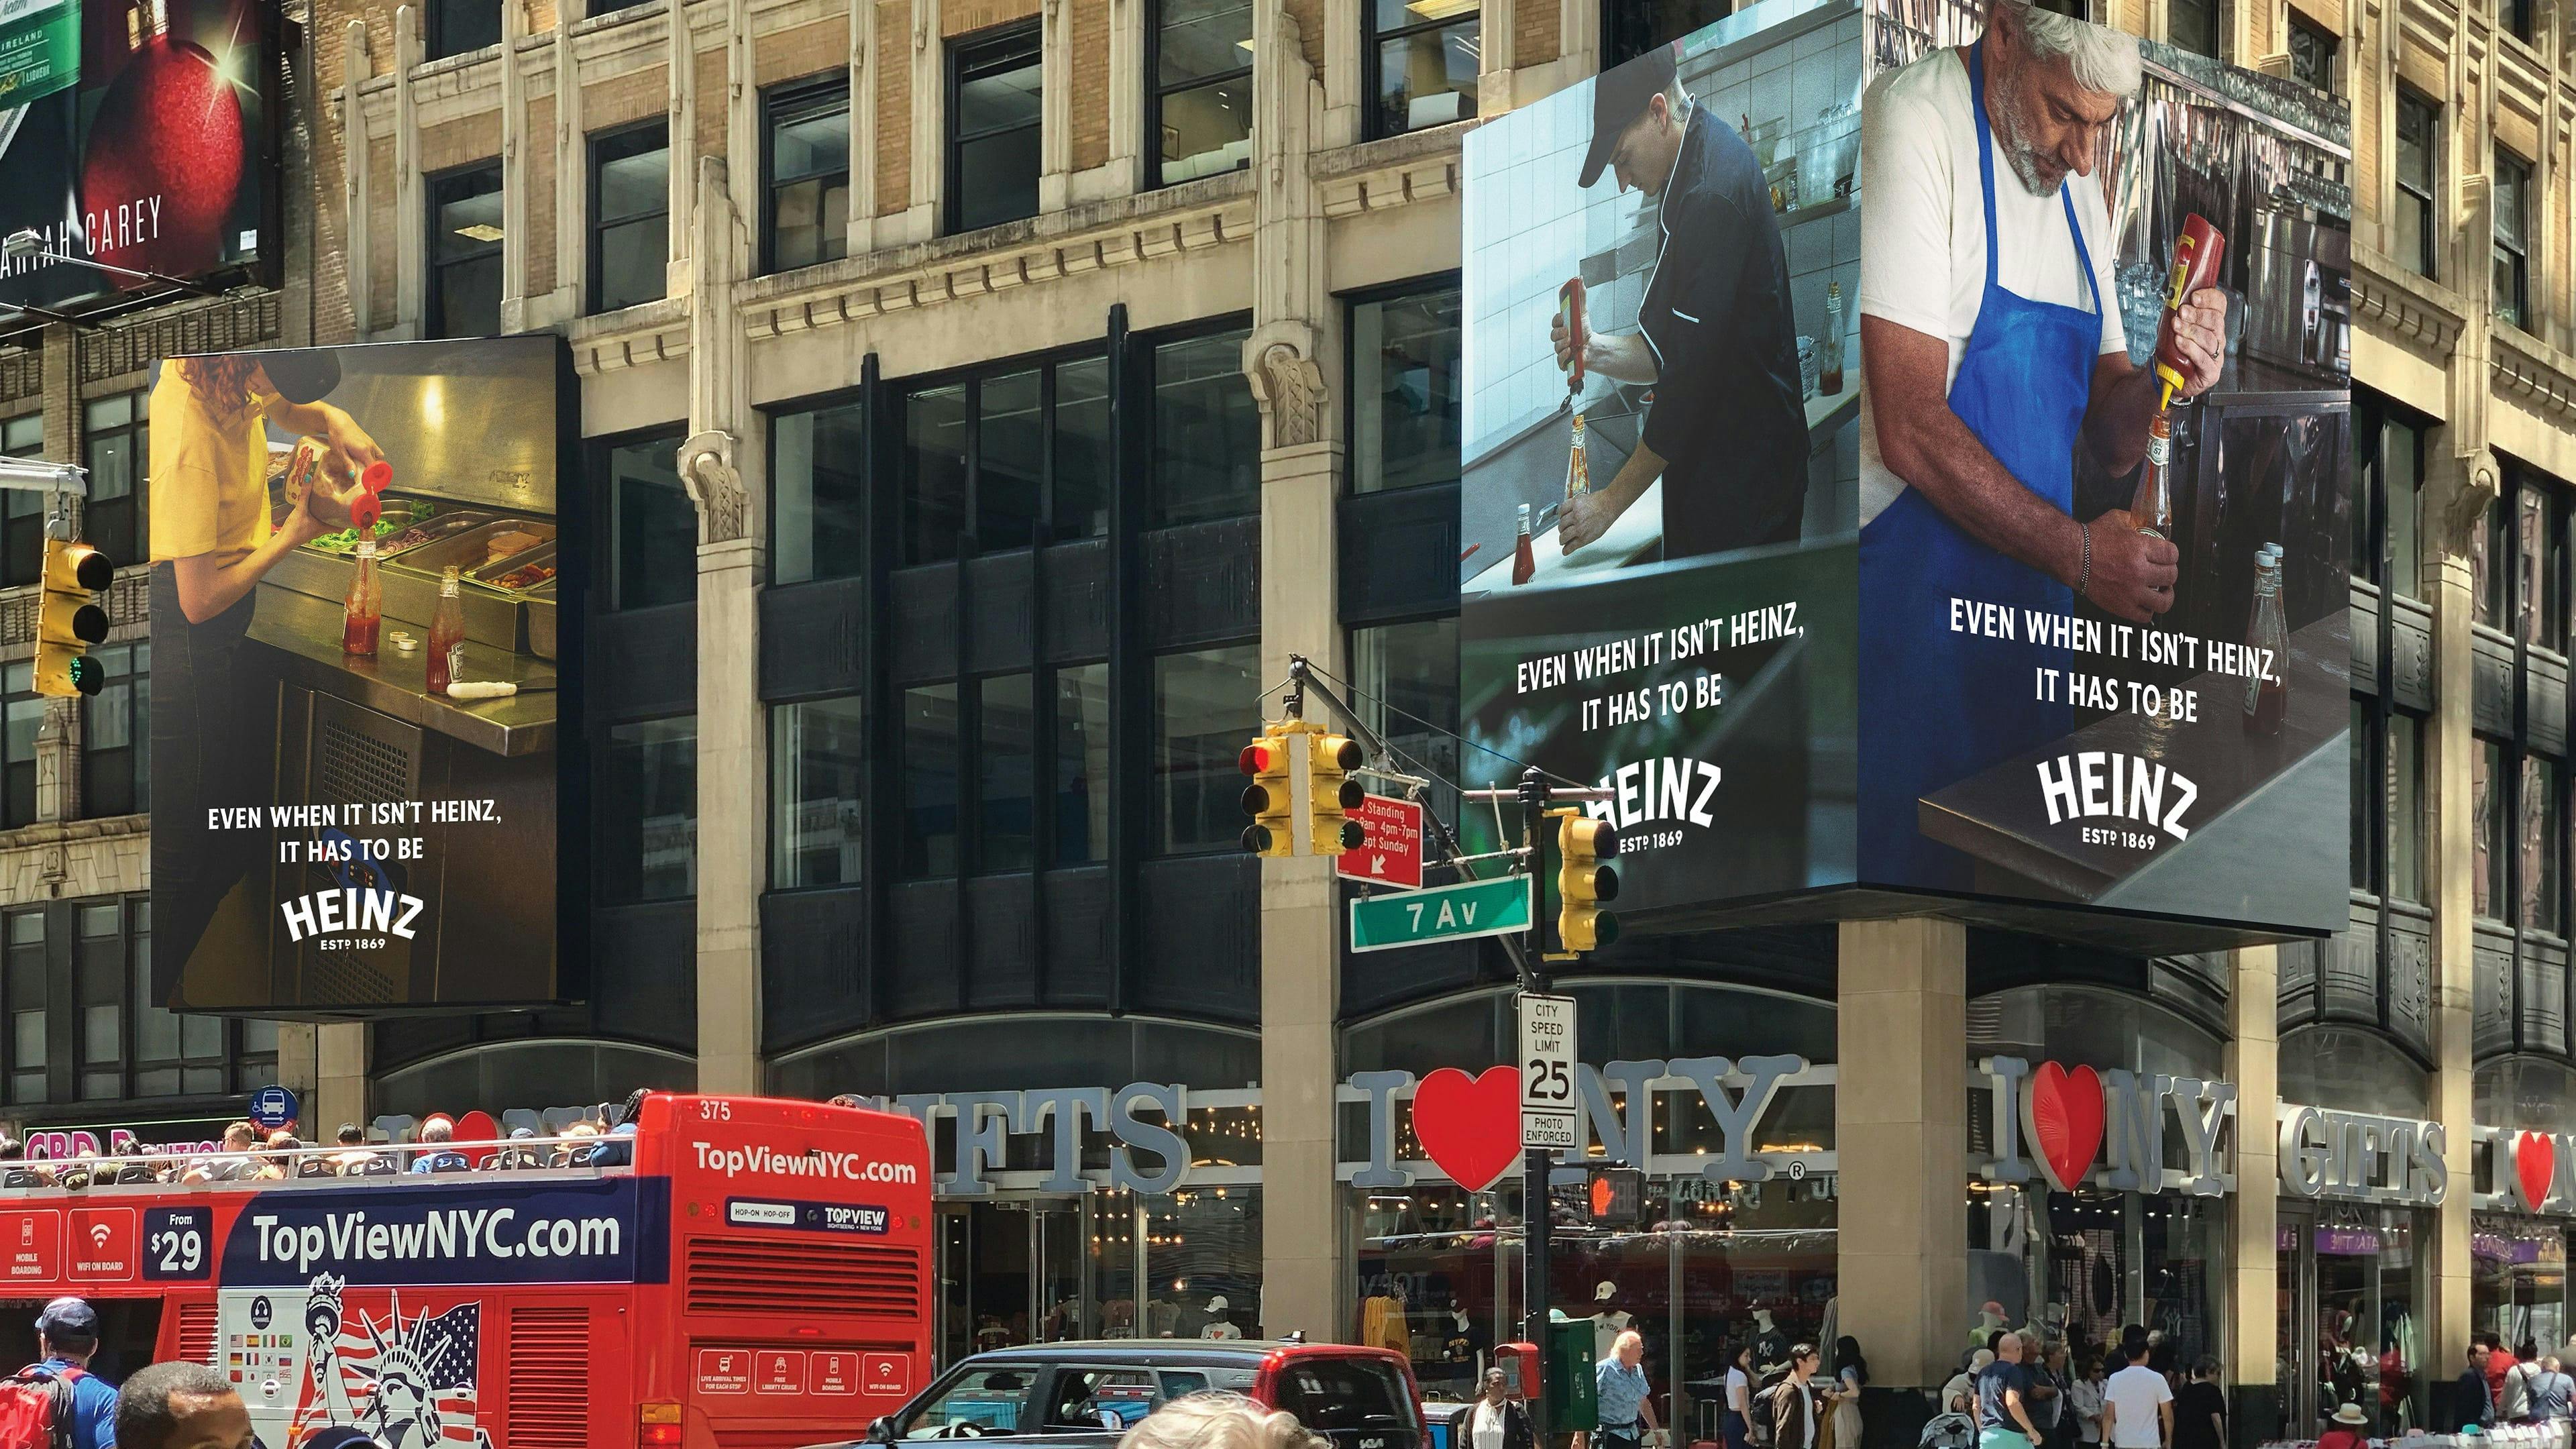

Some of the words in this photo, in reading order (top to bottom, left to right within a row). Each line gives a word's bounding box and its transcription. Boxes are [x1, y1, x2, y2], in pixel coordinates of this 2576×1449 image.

[1, 30, 42, 51] IRELAND
[86, 195, 161, 256] CAREY
[1517, 653, 1566, 694] EVEN
[1573, 638, 1635, 681] WHEN
[1644, 631, 1663, 666] IT
[1670, 618, 1723, 661] ISN'T
[1731, 601, 1803, 647] HEINZ,
[1950, 597, 2015, 639] EVEN
[2025, 609, 2101, 653] WHEN
[2110, 624, 2133, 658] IT
[2141, 629, 2199, 668] ISN'T
[2208, 641, 2281, 686] HEINZ,
[1582, 698, 1601, 732] IT
[1609, 688, 1650, 726] HAS
[1658, 681, 1688, 716] TO
[1696, 673, 1721, 709] BE
[2037, 667, 2059, 702] IT
[2069, 672, 2118, 711] HAS
[2127, 682, 2161, 716] TO
[2170, 688, 2197, 722] BE
[2036, 751, 2197, 841] HEINZ
[209, 807, 261, 829] EVEN
[270, 805, 335, 827] WHEN
[343, 804, 363, 825] IT
[372, 802, 423, 824] ISN'T
[431, 800, 501, 824] HEINZ,
[1367, 801, 1405, 823] Standing
[1381, 821, 1417, 839] 4pm-7pm
[1652, 830, 1682, 849] 1869
[2121, 832, 2155, 850] 1869
[280, 841, 300, 863] IT
[308, 839, 352, 862] HAS
[360, 839, 389, 861] TO
[398, 838, 423, 859] BE
[1379, 837, 1409, 857] Sunday
[280, 888, 423, 942] HEINZ
[1406, 903, 1424, 932] 7
[1436, 899, 1477, 929] Av
[355, 938, 385, 949] 1869
[1536, 1004, 1558, 1017] CITY
[1531, 1022, 1563, 1035] SPEED
[1536, 1040, 1560, 1052] LIMIT
[1529, 1059, 1569, 1100] 25
[700, 1099, 731, 1121] 375
[1351, 1071, 1414, 1188] I
[1551, 1054, 1809, 1186] NY
[253, 1120, 262, 1130] NO
[1535, 1118, 1563, 1129] PHOTO
[1980, 1055, 2029, 1182] I
[2095, 1068, 2238, 1198] NY
[1526, 1130, 1571, 1142] ENFORCED
[25, 1130, 97, 1173] CBD
[692, 1141, 916, 1184] TopViewNYC.com
[2279, 1106, 2447, 1205] GIFTS
[170, 1214, 193, 1226] From
[735, 1208, 759, 1216] HOP-ON
[763, 1210, 790, 1218] HOP-OFF
[825, 1208, 885, 1226] TOPVIEW
[151, 1230, 201, 1271] $29
[253, 1208, 620, 1273] TopViewNYC.com
[16, 1253, 38, 1262] MOBILE
[77, 1262, 91, 1271] WIFI
[92, 1262, 100, 1271] ON
[101, 1262, 123, 1271] BOARD
[11, 1266, 42, 1275] BOARDING
[1448, 1338, 1470, 1347] NYPD
